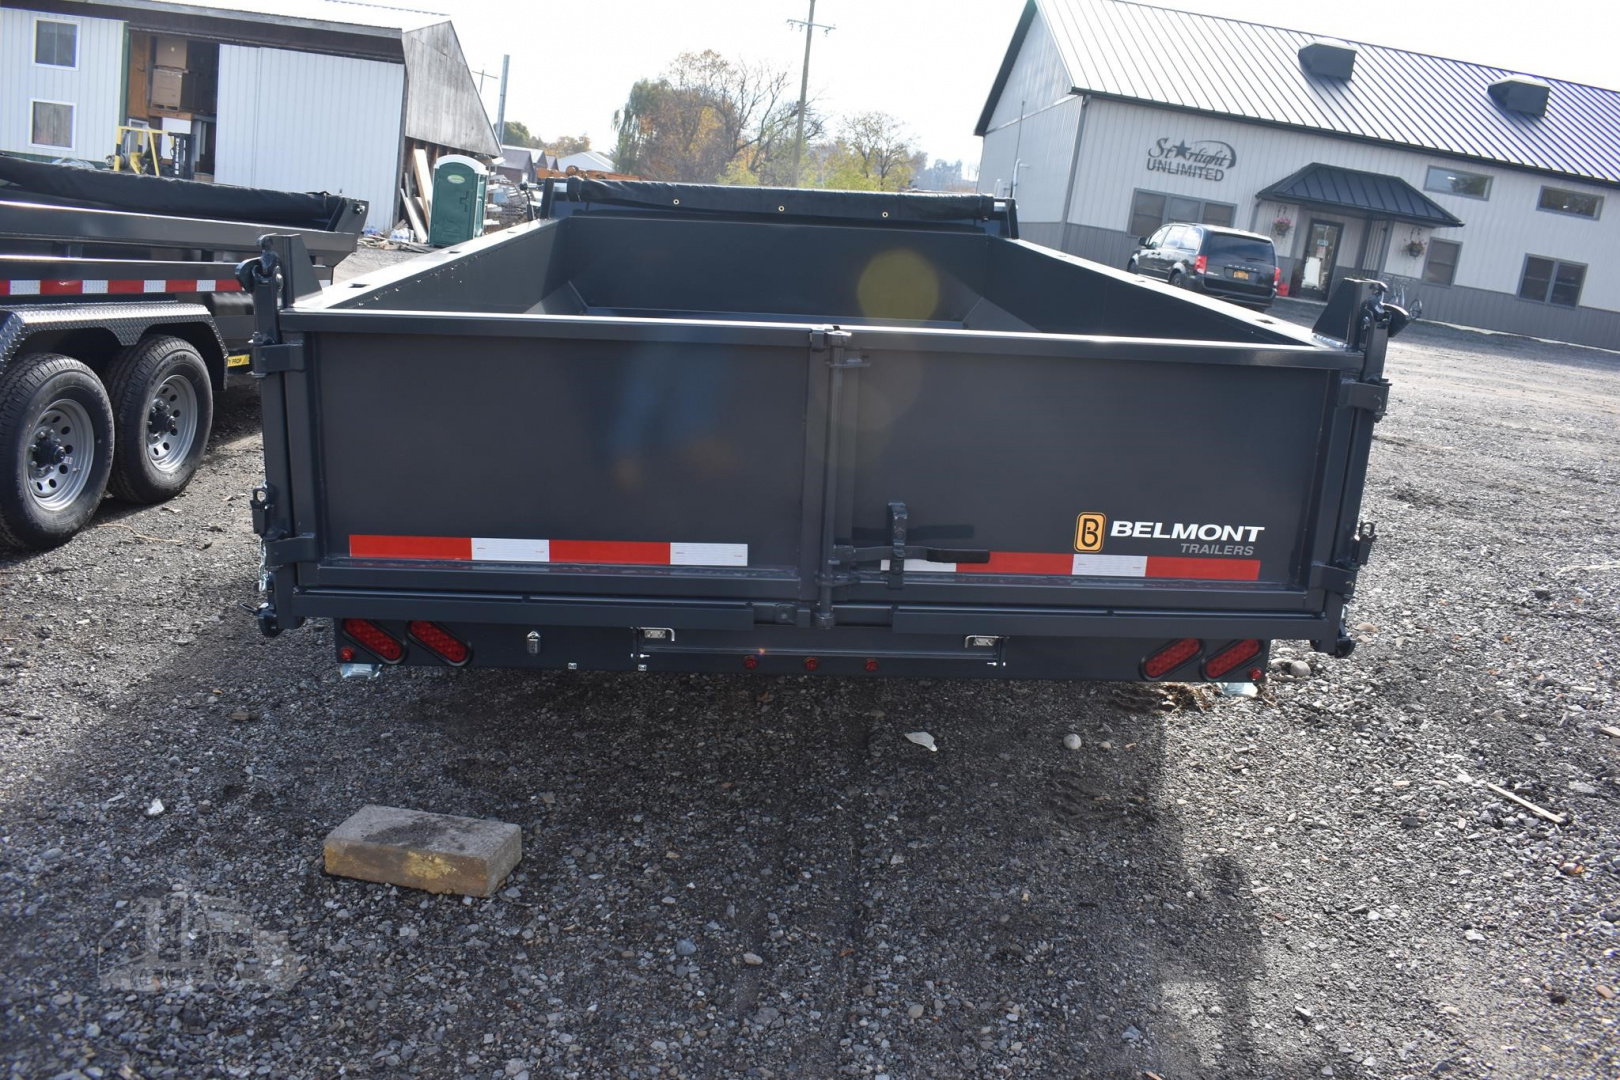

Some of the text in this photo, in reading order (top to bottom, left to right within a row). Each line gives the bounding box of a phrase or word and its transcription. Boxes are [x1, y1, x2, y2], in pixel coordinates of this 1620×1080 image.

[1146, 158, 1225, 182] UNLIMITED
[1110, 520, 1265, 542] BELMONT
[1180, 543, 1254, 556] TRAILERS
